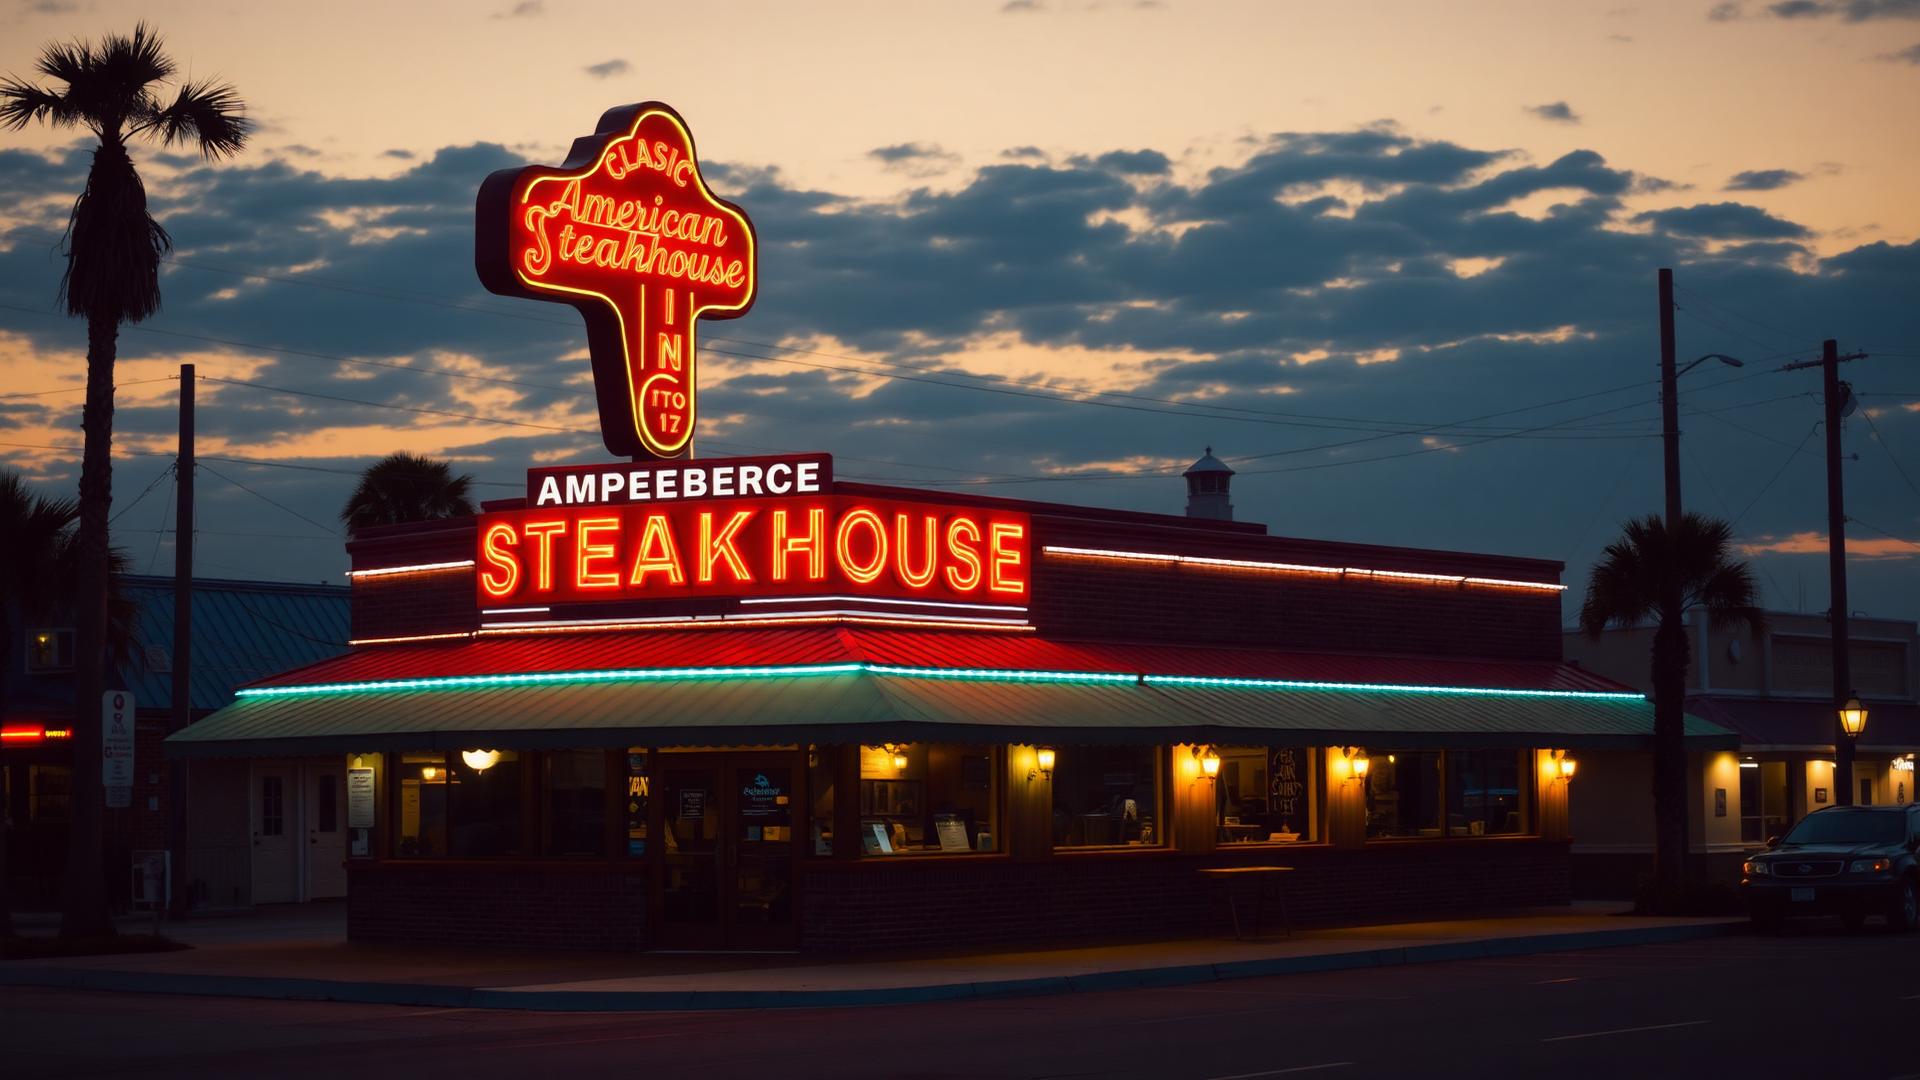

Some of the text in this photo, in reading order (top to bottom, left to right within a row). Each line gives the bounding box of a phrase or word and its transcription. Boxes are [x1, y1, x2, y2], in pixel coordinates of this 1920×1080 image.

[605, 138, 693, 188] CLASIC
[549, 180, 728, 248] American
[537, 462, 820, 506] AMPEEBERCE
[481, 508, 1026, 597] STEAKHOUSE
